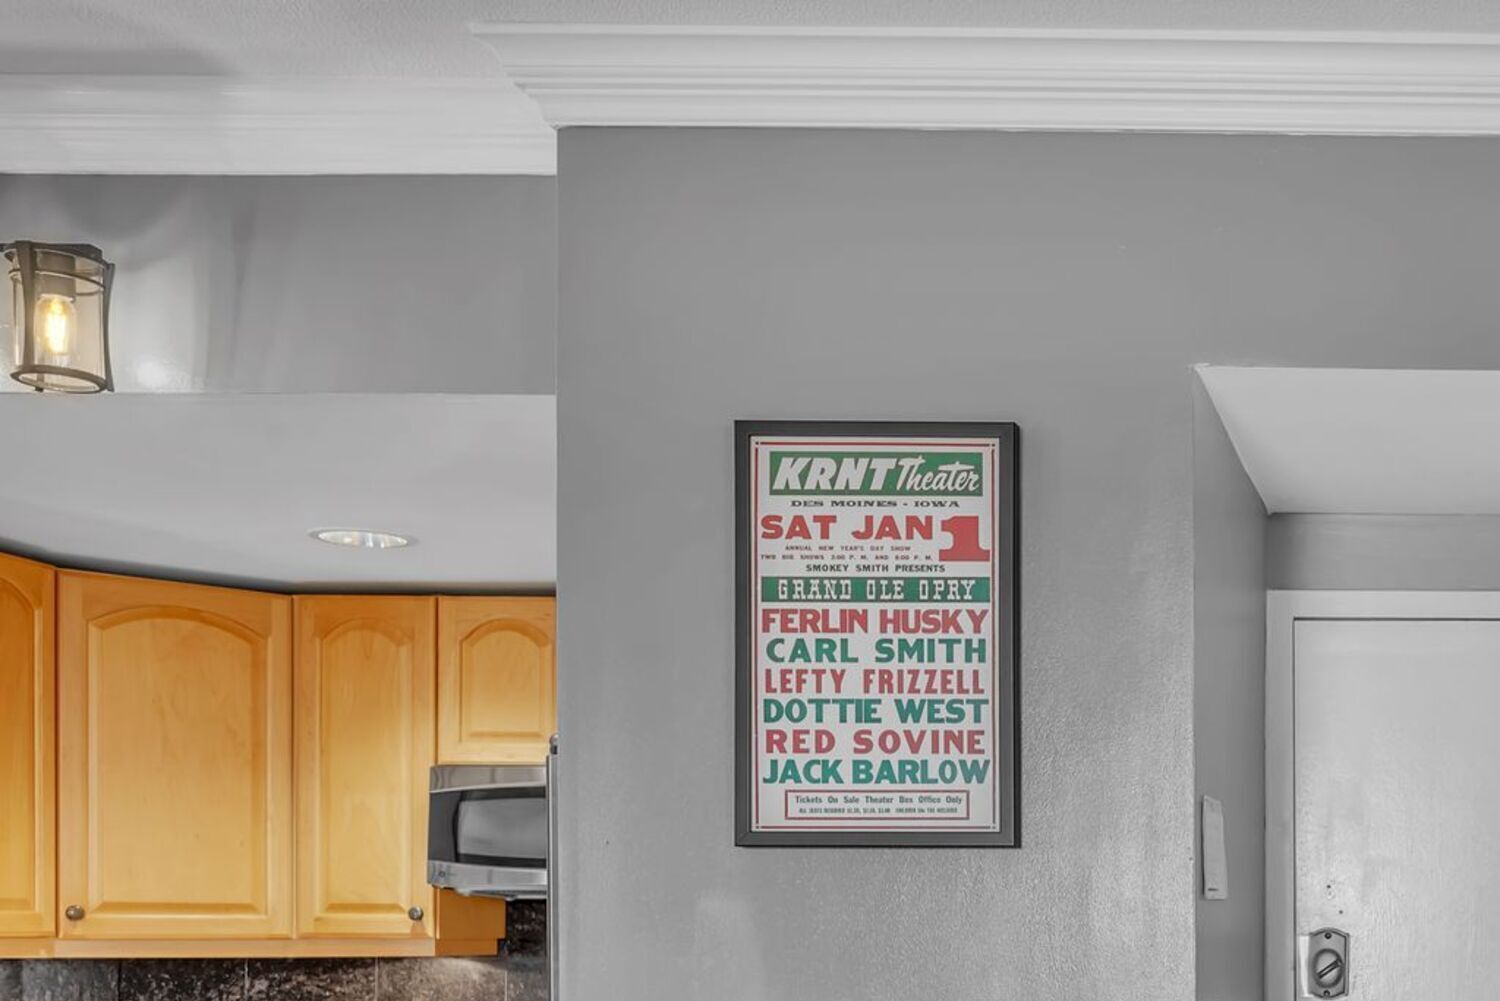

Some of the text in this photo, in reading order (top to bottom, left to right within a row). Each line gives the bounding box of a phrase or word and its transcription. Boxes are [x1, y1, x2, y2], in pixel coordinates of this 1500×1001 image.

[772, 455, 980, 492] KRNT Theater
[761, 515, 990, 562] SAT JAN 1
[806, 564, 946, 573] SMOKEY SMITH PRESENTS
[778, 580, 976, 600] GRAND OLE OPRY
[761, 609, 989, 634] FERLIN HUSKY
[766, 638, 986, 663] CARL SMITH
[765, 669, 985, 694] LEFTY FRIZZELL
[763, 699, 989, 723] DOTTIE WEST
[765, 729, 985, 754] RED SOVINE
[762, 759, 990, 784] JACK BARLOW
[796, 796, 962, 805] Tickets On Sale Theater Box Office Only
